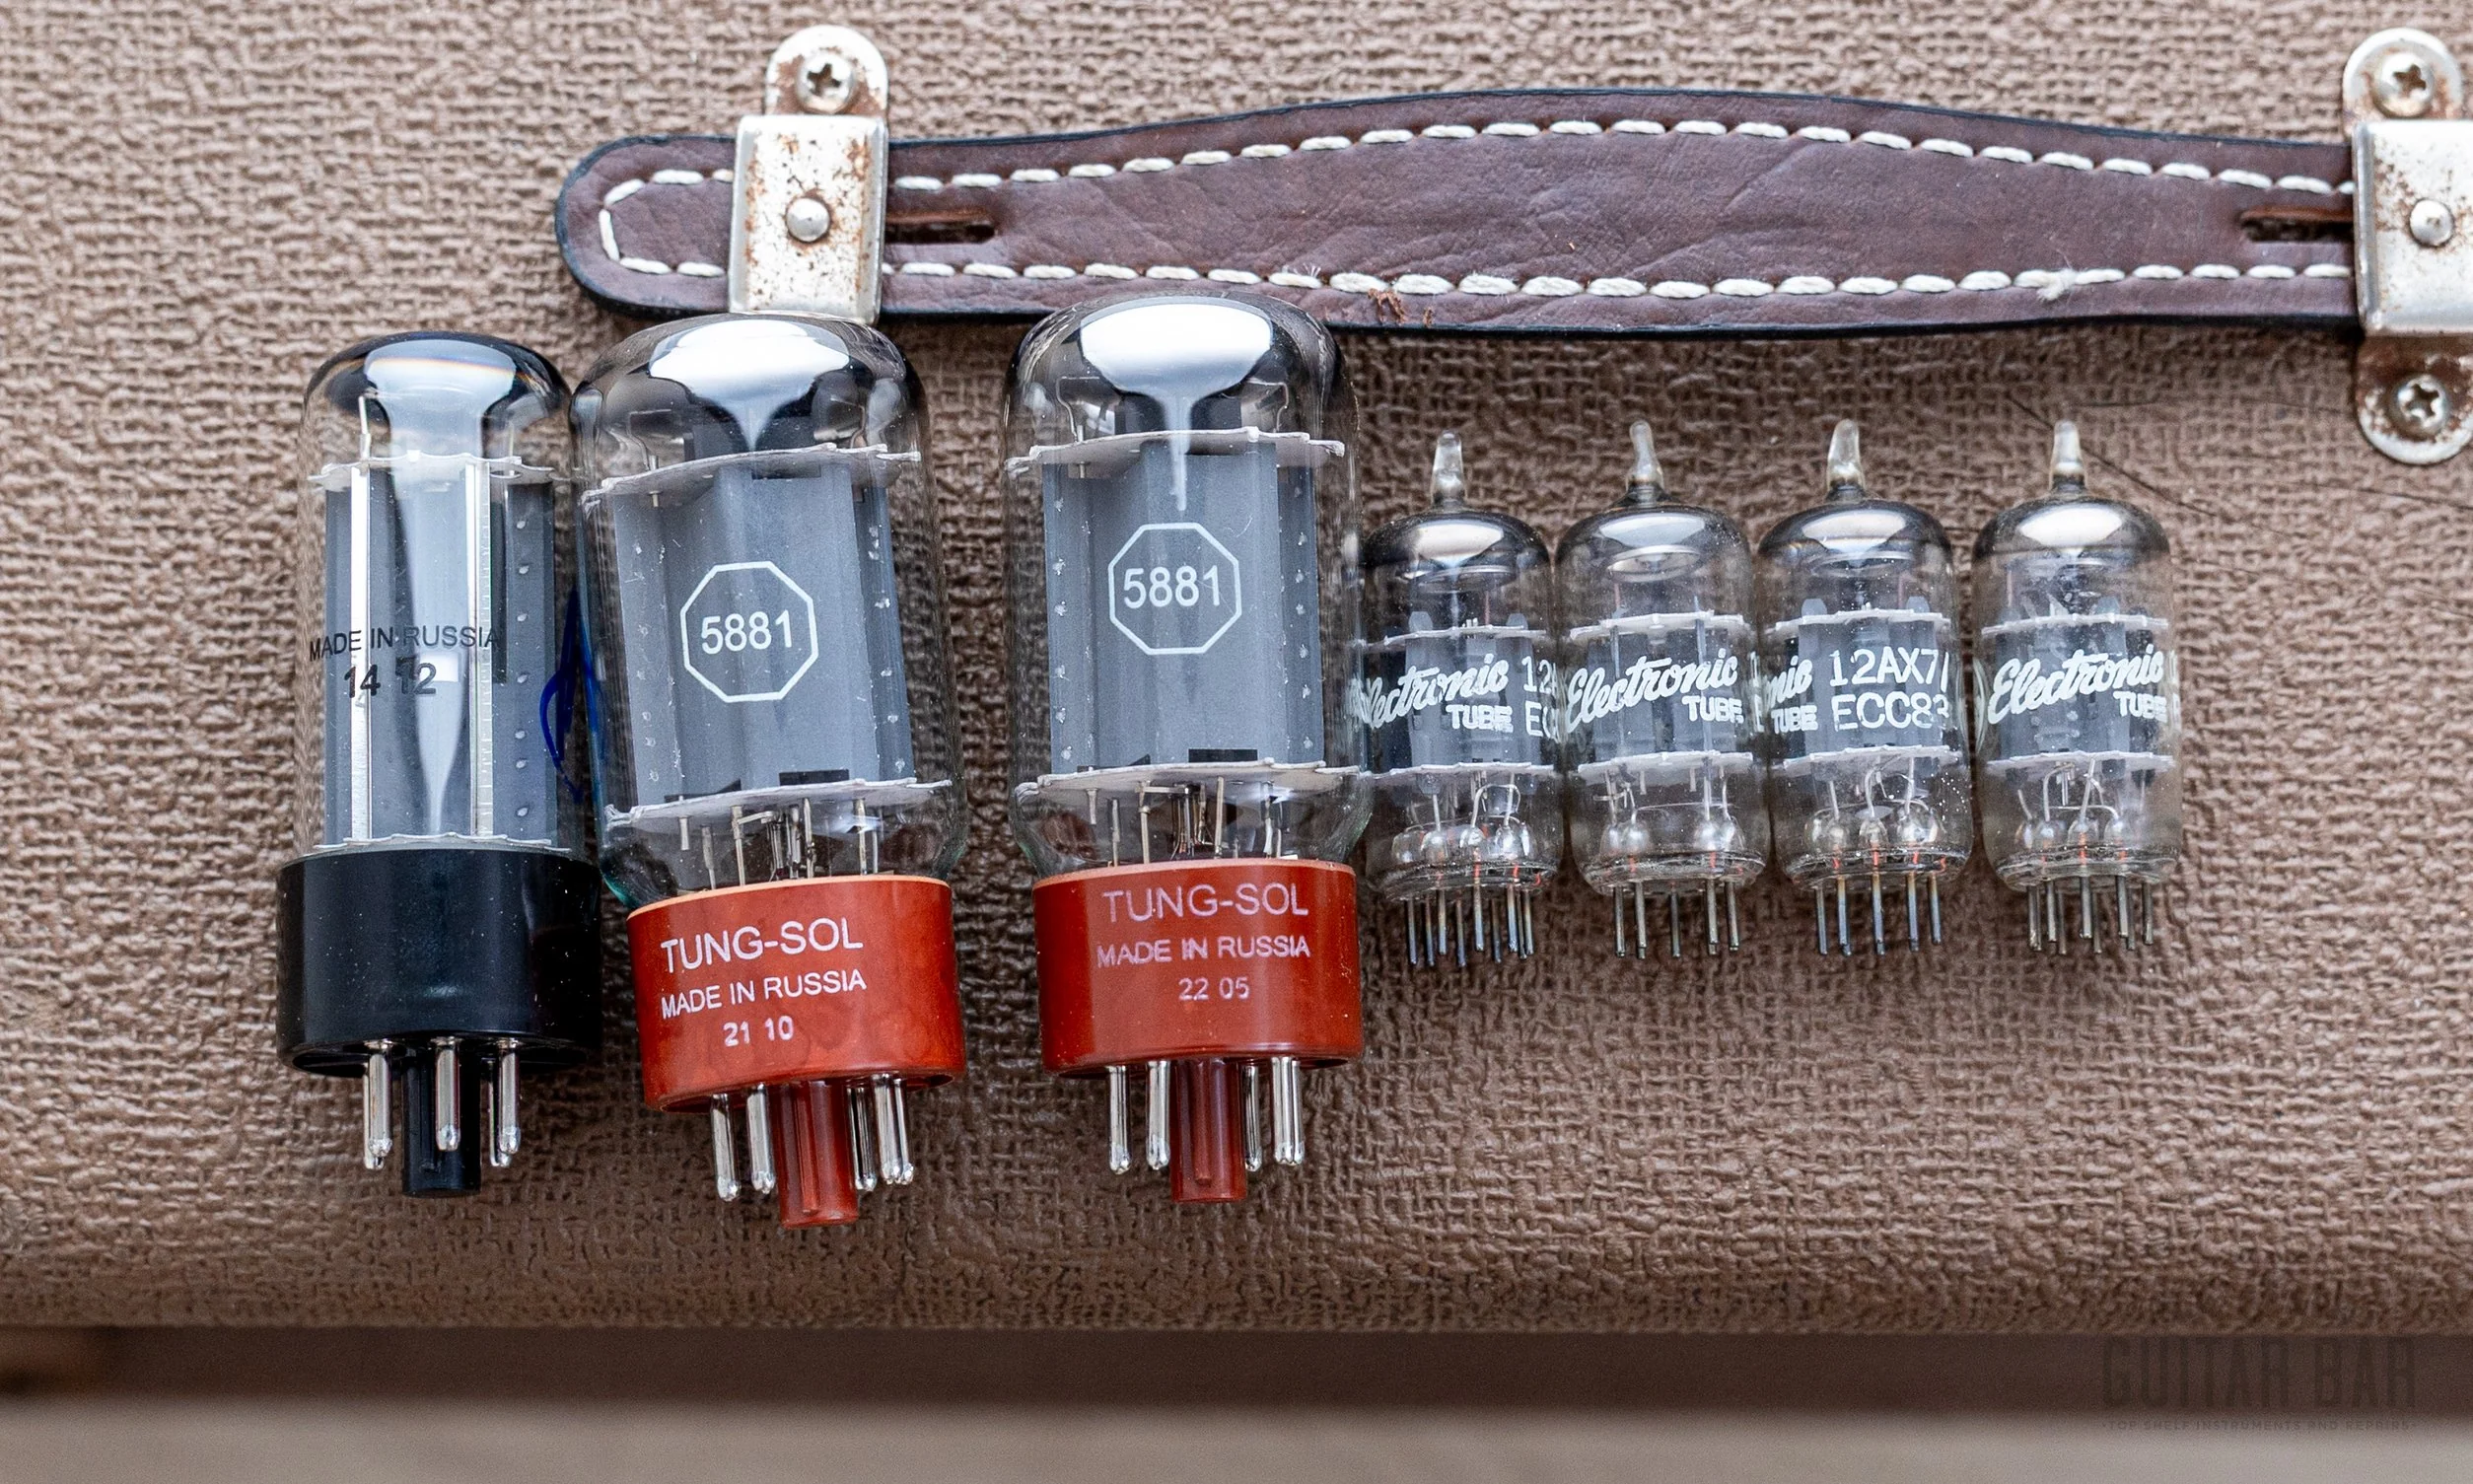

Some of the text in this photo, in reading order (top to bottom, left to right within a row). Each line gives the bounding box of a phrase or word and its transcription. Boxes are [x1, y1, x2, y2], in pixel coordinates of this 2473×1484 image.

[1123, 565, 1222, 609] 5881
[310, 625, 501, 662] MADE IN RUSSIA
[700, 609, 793, 656] 5881
[344, 664, 382, 698] 14
[1829, 646, 1950, 692] 12AX7/
[1988, 644, 2164, 724] Electronic
[1566, 648, 1738, 734] Electronic
[2113, 691, 2167, 723] TUBE
[1446, 704, 1514, 734] TUBE
[1682, 696, 1744, 724] TUBE
[1771, 705, 1818, 734] TUBE
[1103, 883, 1309, 923] TUNG-SOL
[661, 917, 864, 973] TUNG-SOL
[1096, 935, 1311, 969] MADE IN RUSSIA
[662, 969, 868, 1020] MADE IN RUSSIA
[1178, 976, 1250, 1001] 22 05
[723, 1016, 795, 1047] 21 10
